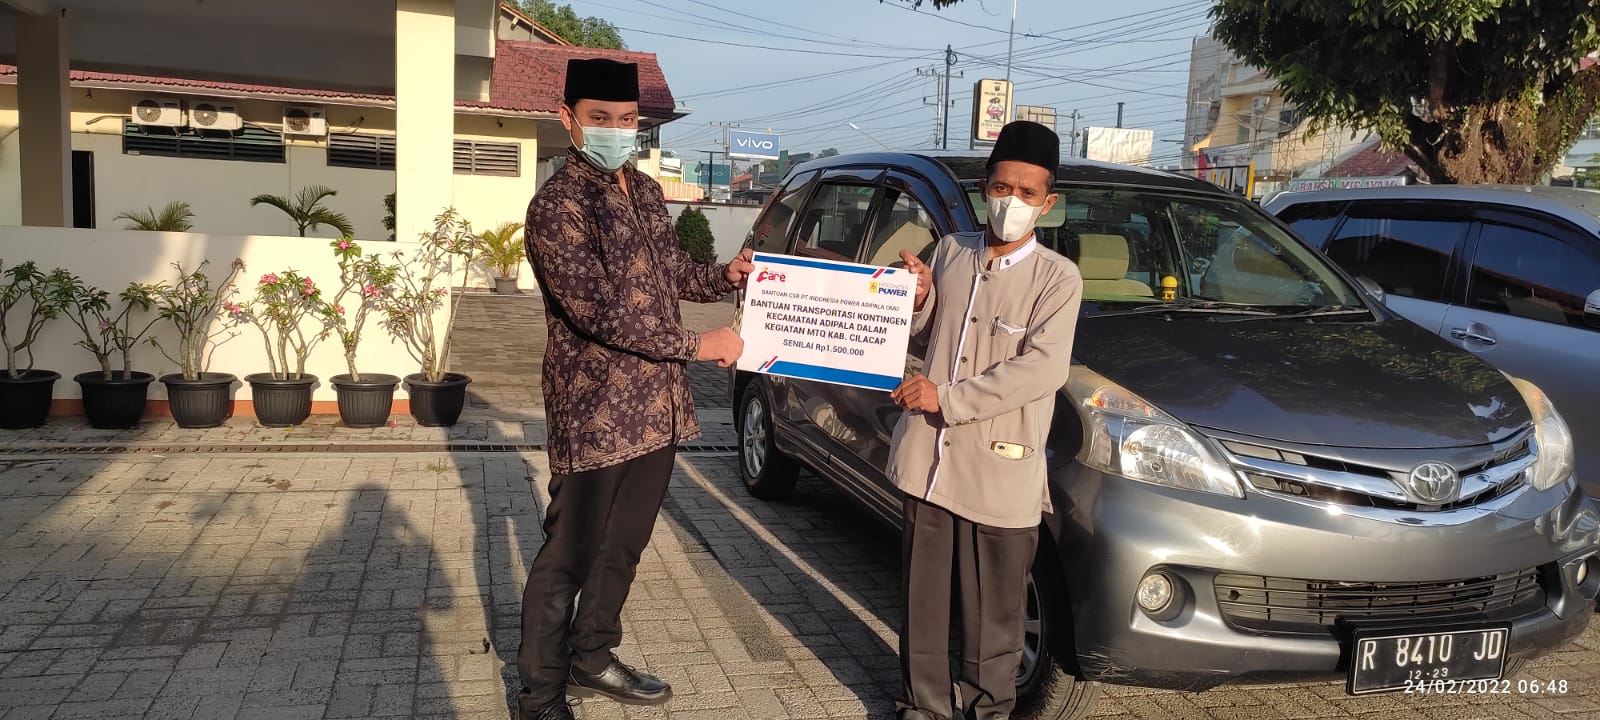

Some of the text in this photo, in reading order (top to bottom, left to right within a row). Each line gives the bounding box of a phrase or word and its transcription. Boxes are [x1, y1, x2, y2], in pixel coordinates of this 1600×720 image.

[736, 137, 773, 150] vivo
[761, 289, 788, 298] BANTUAN
[809, 295, 839, 304] INDONESIA
[840, 299, 860, 307] POWER
[860, 301, 885, 310] ADIPALA
[878, 287, 908, 297] POWER
[750, 299, 907, 326] BANTUAN TRANSPORTASI KONTINGEN
[766, 311, 887, 335] KECAMATAN ADIPALA DALAM
[764, 322, 887, 346] KEGIATAN MTQ KAB. CILACAP
[783, 339, 865, 357] SENILAI Rp1.500.000
[1361, 631, 1503, 671] R 8410 JD
